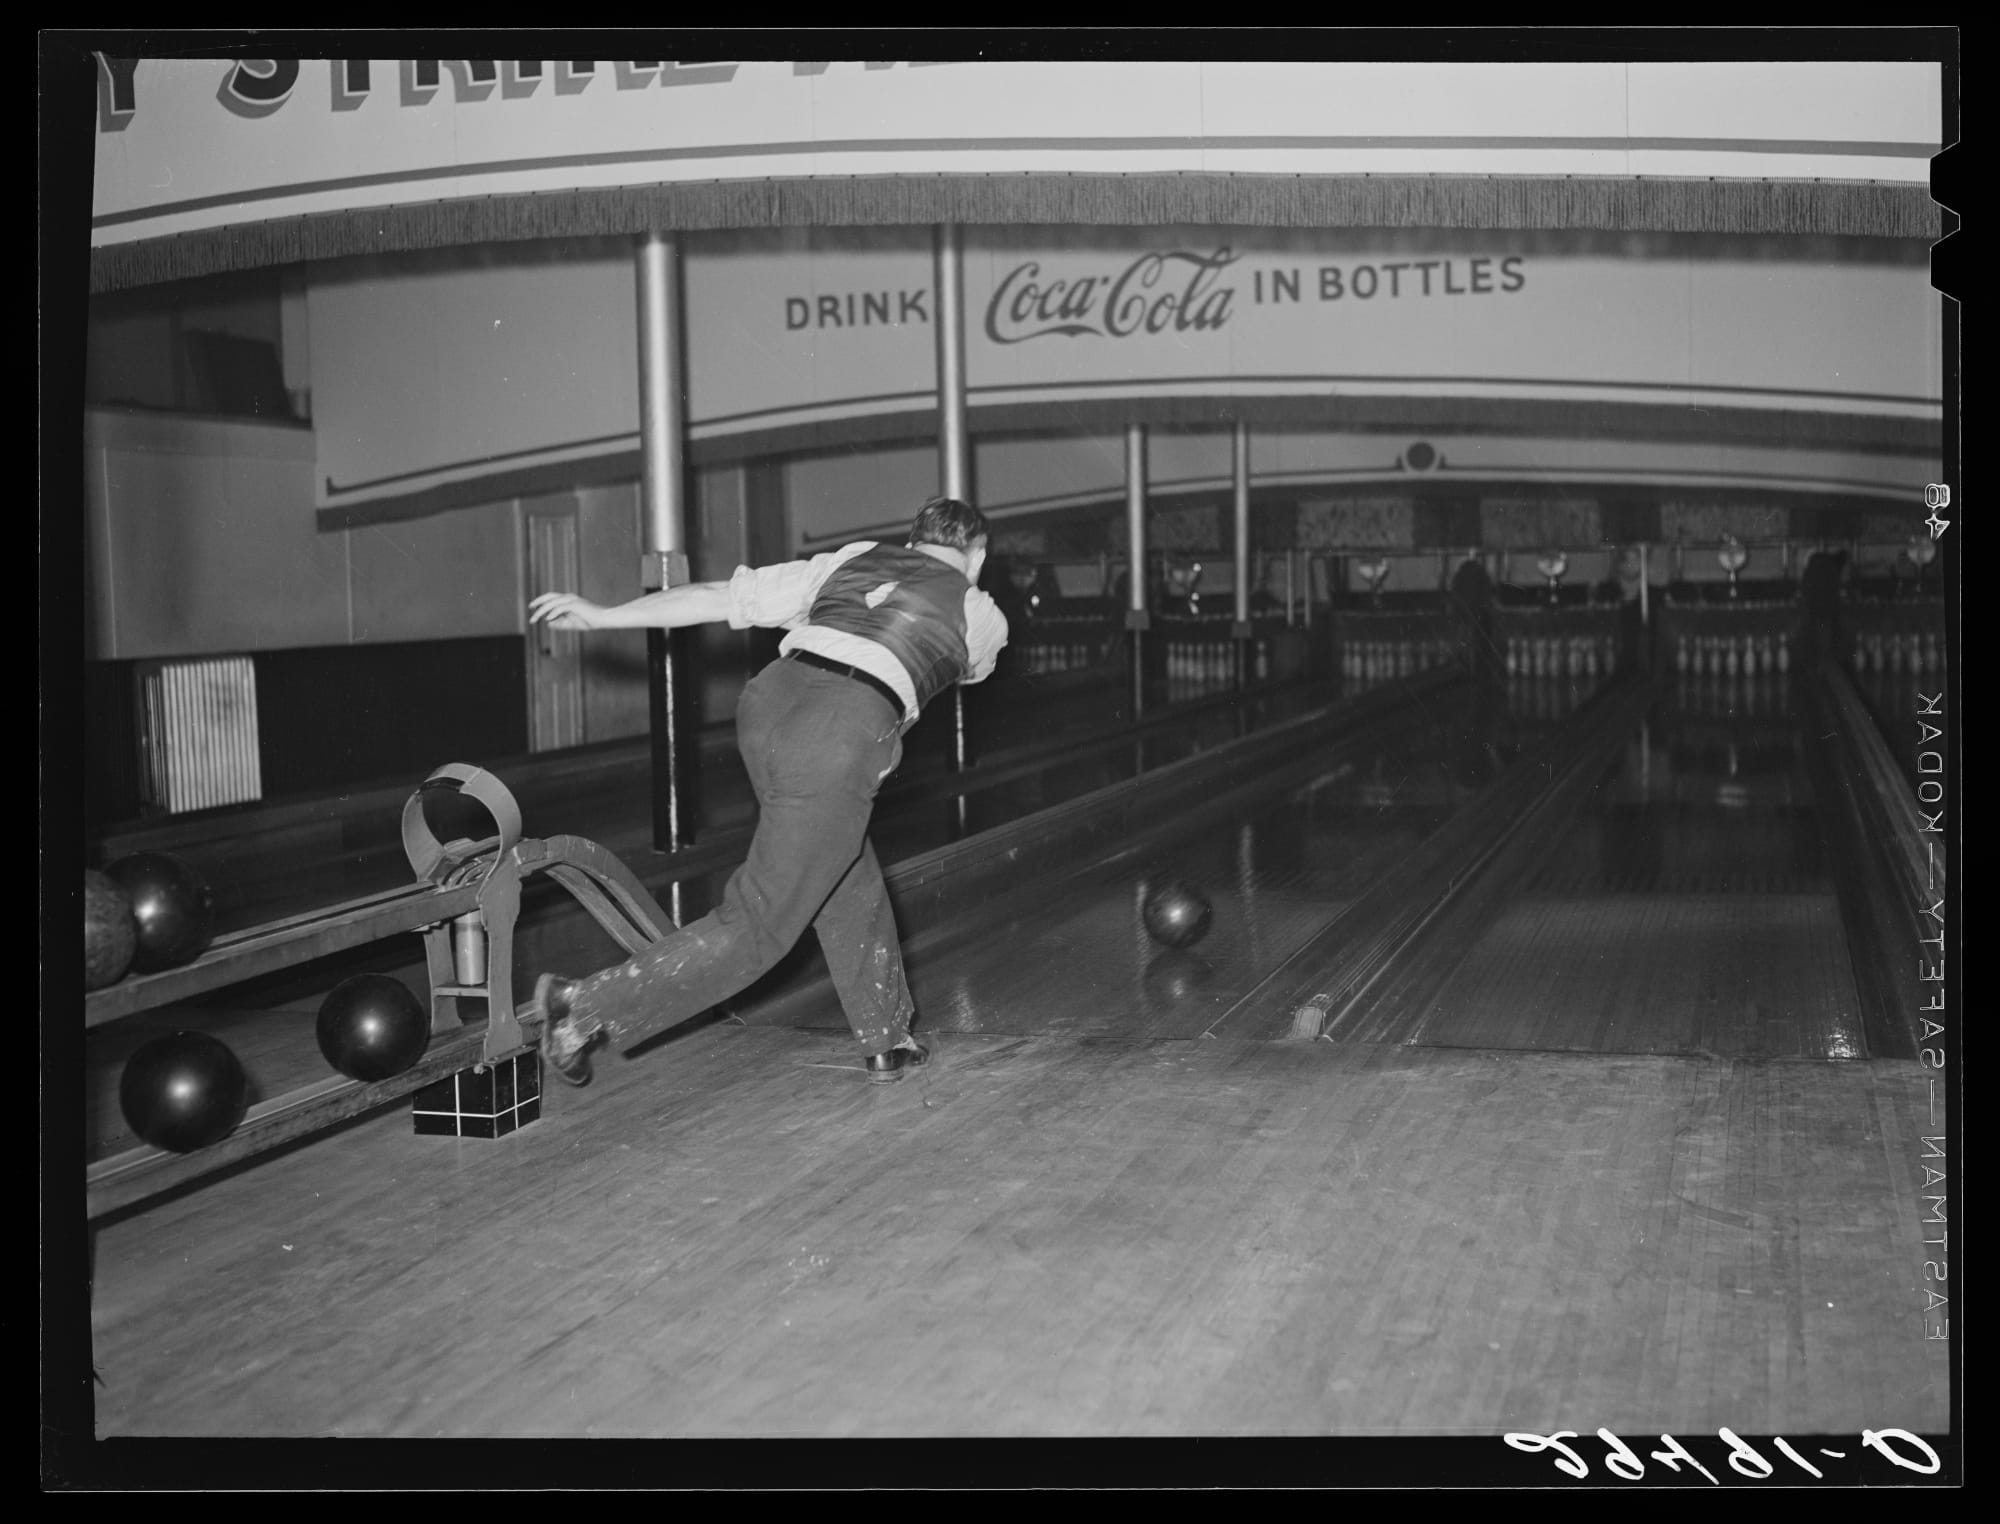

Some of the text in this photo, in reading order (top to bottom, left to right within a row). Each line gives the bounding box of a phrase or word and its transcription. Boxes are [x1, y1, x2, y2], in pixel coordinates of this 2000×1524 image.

[785, 246, 1526, 345] DRINK Coca-Cola IN BOTTLES
